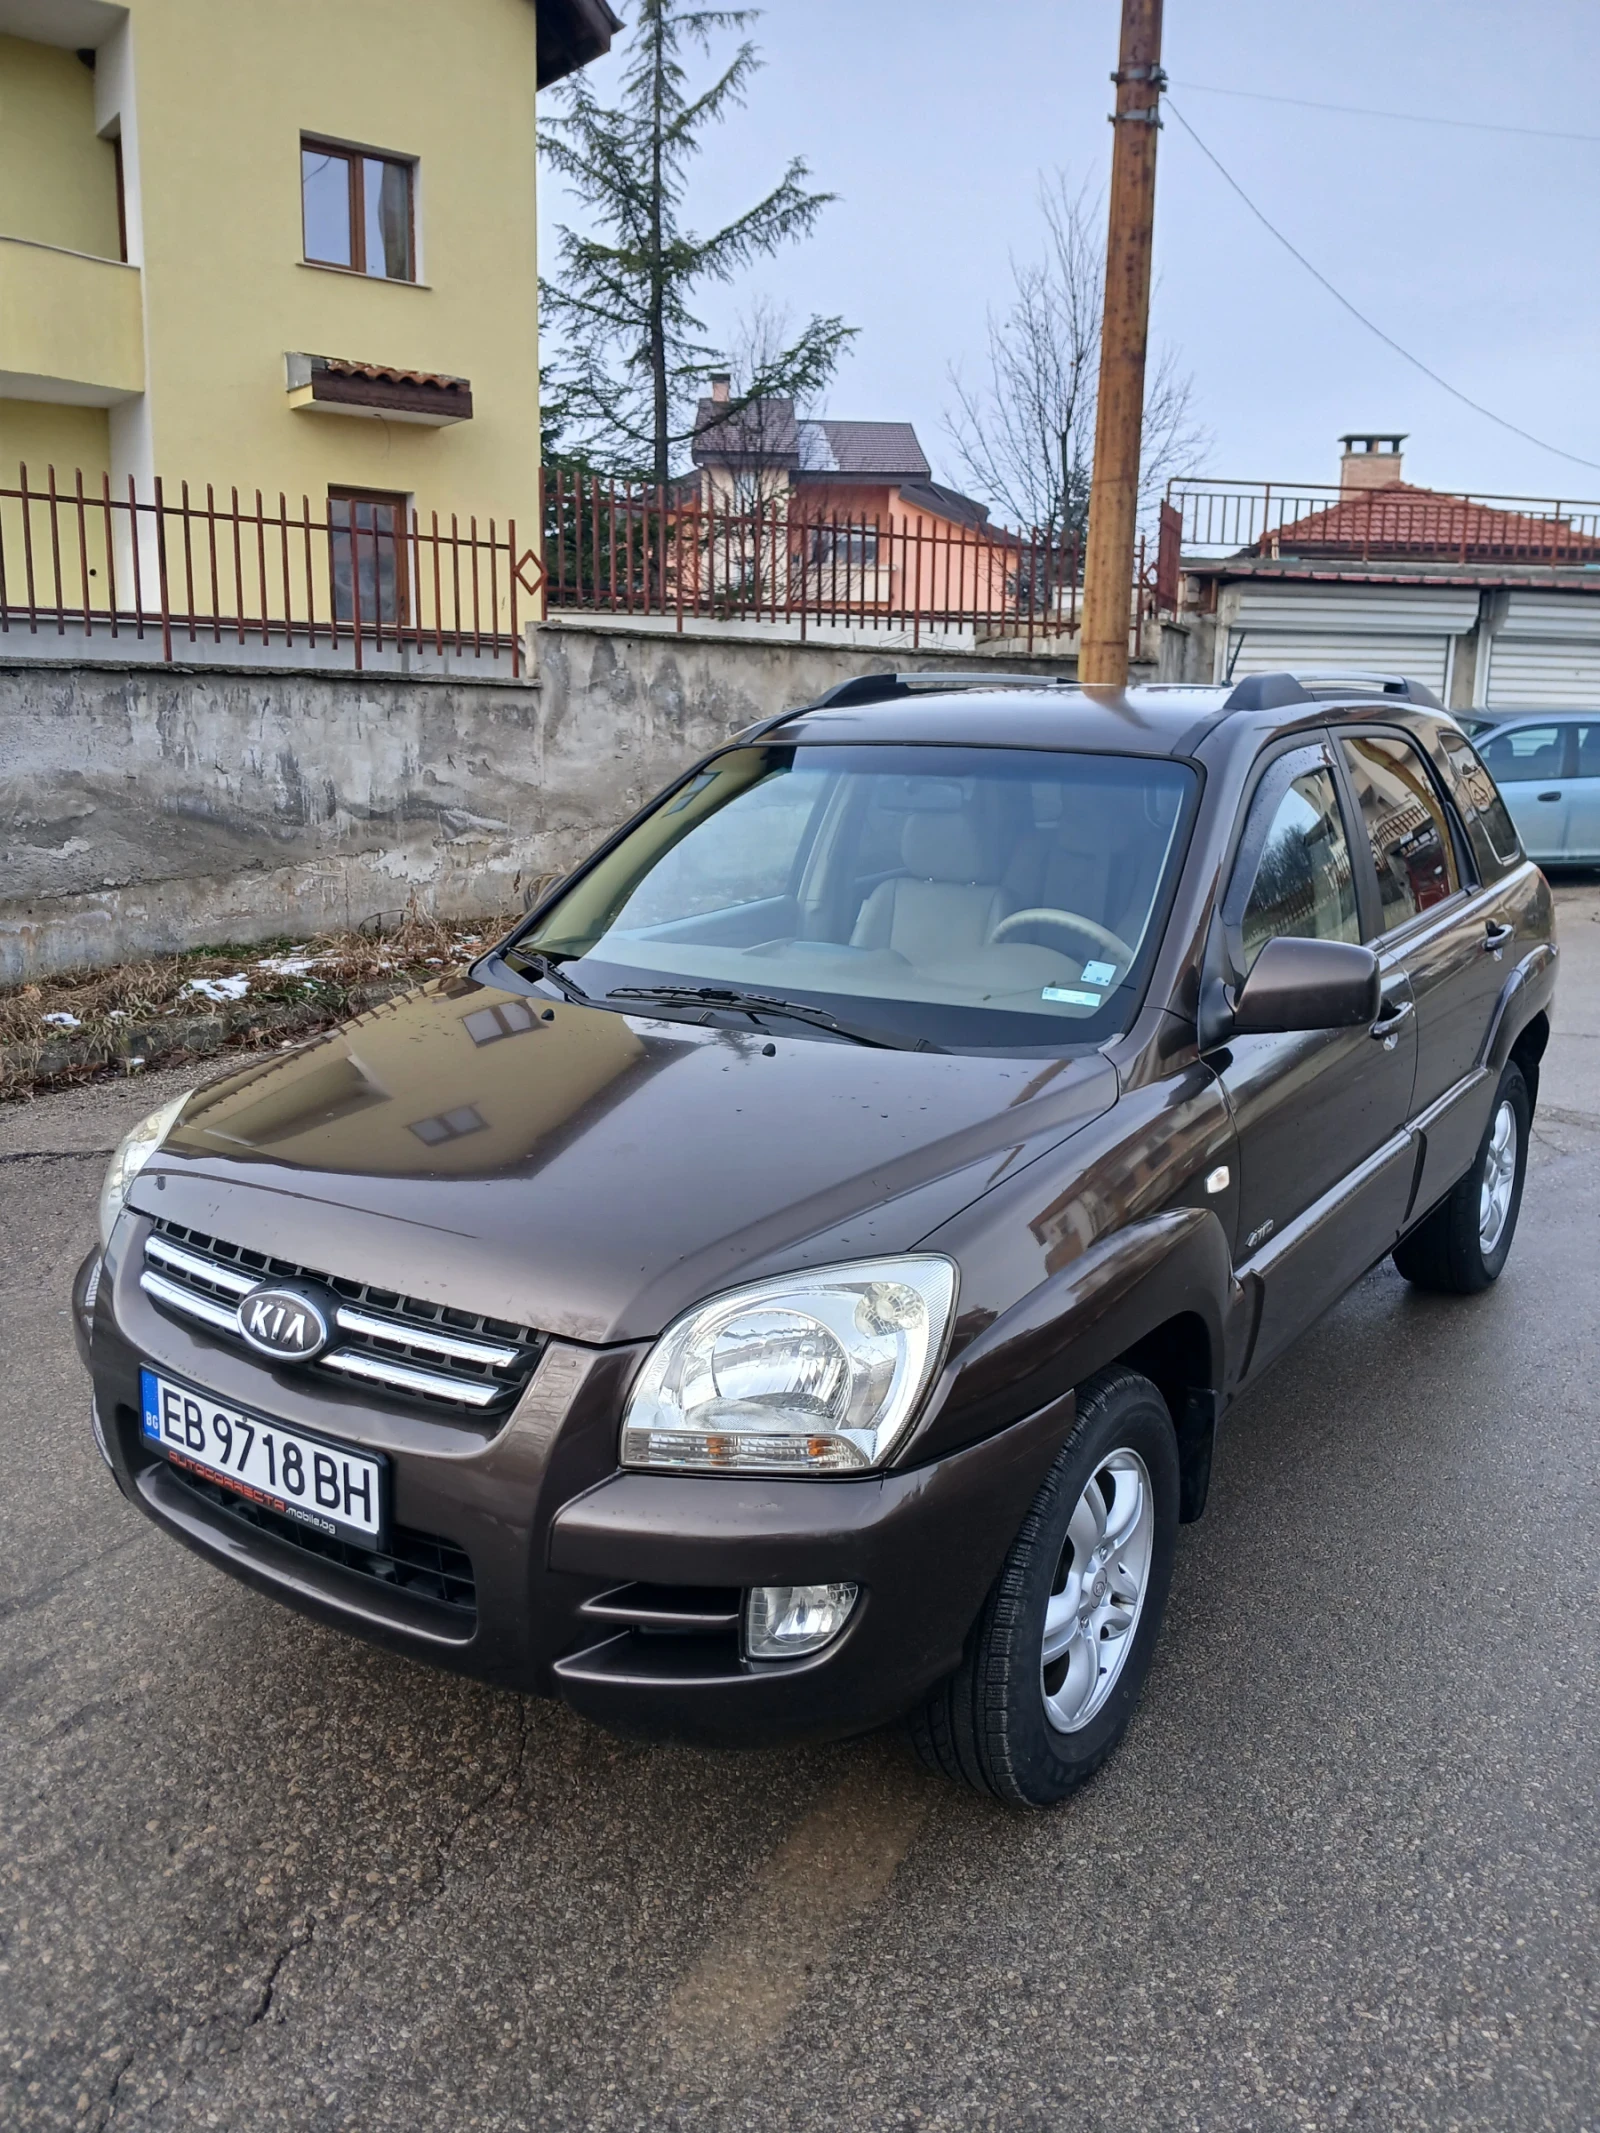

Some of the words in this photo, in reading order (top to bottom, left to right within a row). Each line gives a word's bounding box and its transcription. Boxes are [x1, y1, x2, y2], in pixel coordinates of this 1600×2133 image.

[249, 1300, 306, 1350] KIA
[146, 1410, 159, 1430] BG
[162, 1387, 205, 1452] EB
[213, 1413, 305, 1497] 9718
[313, 1451, 372, 1523] BH
